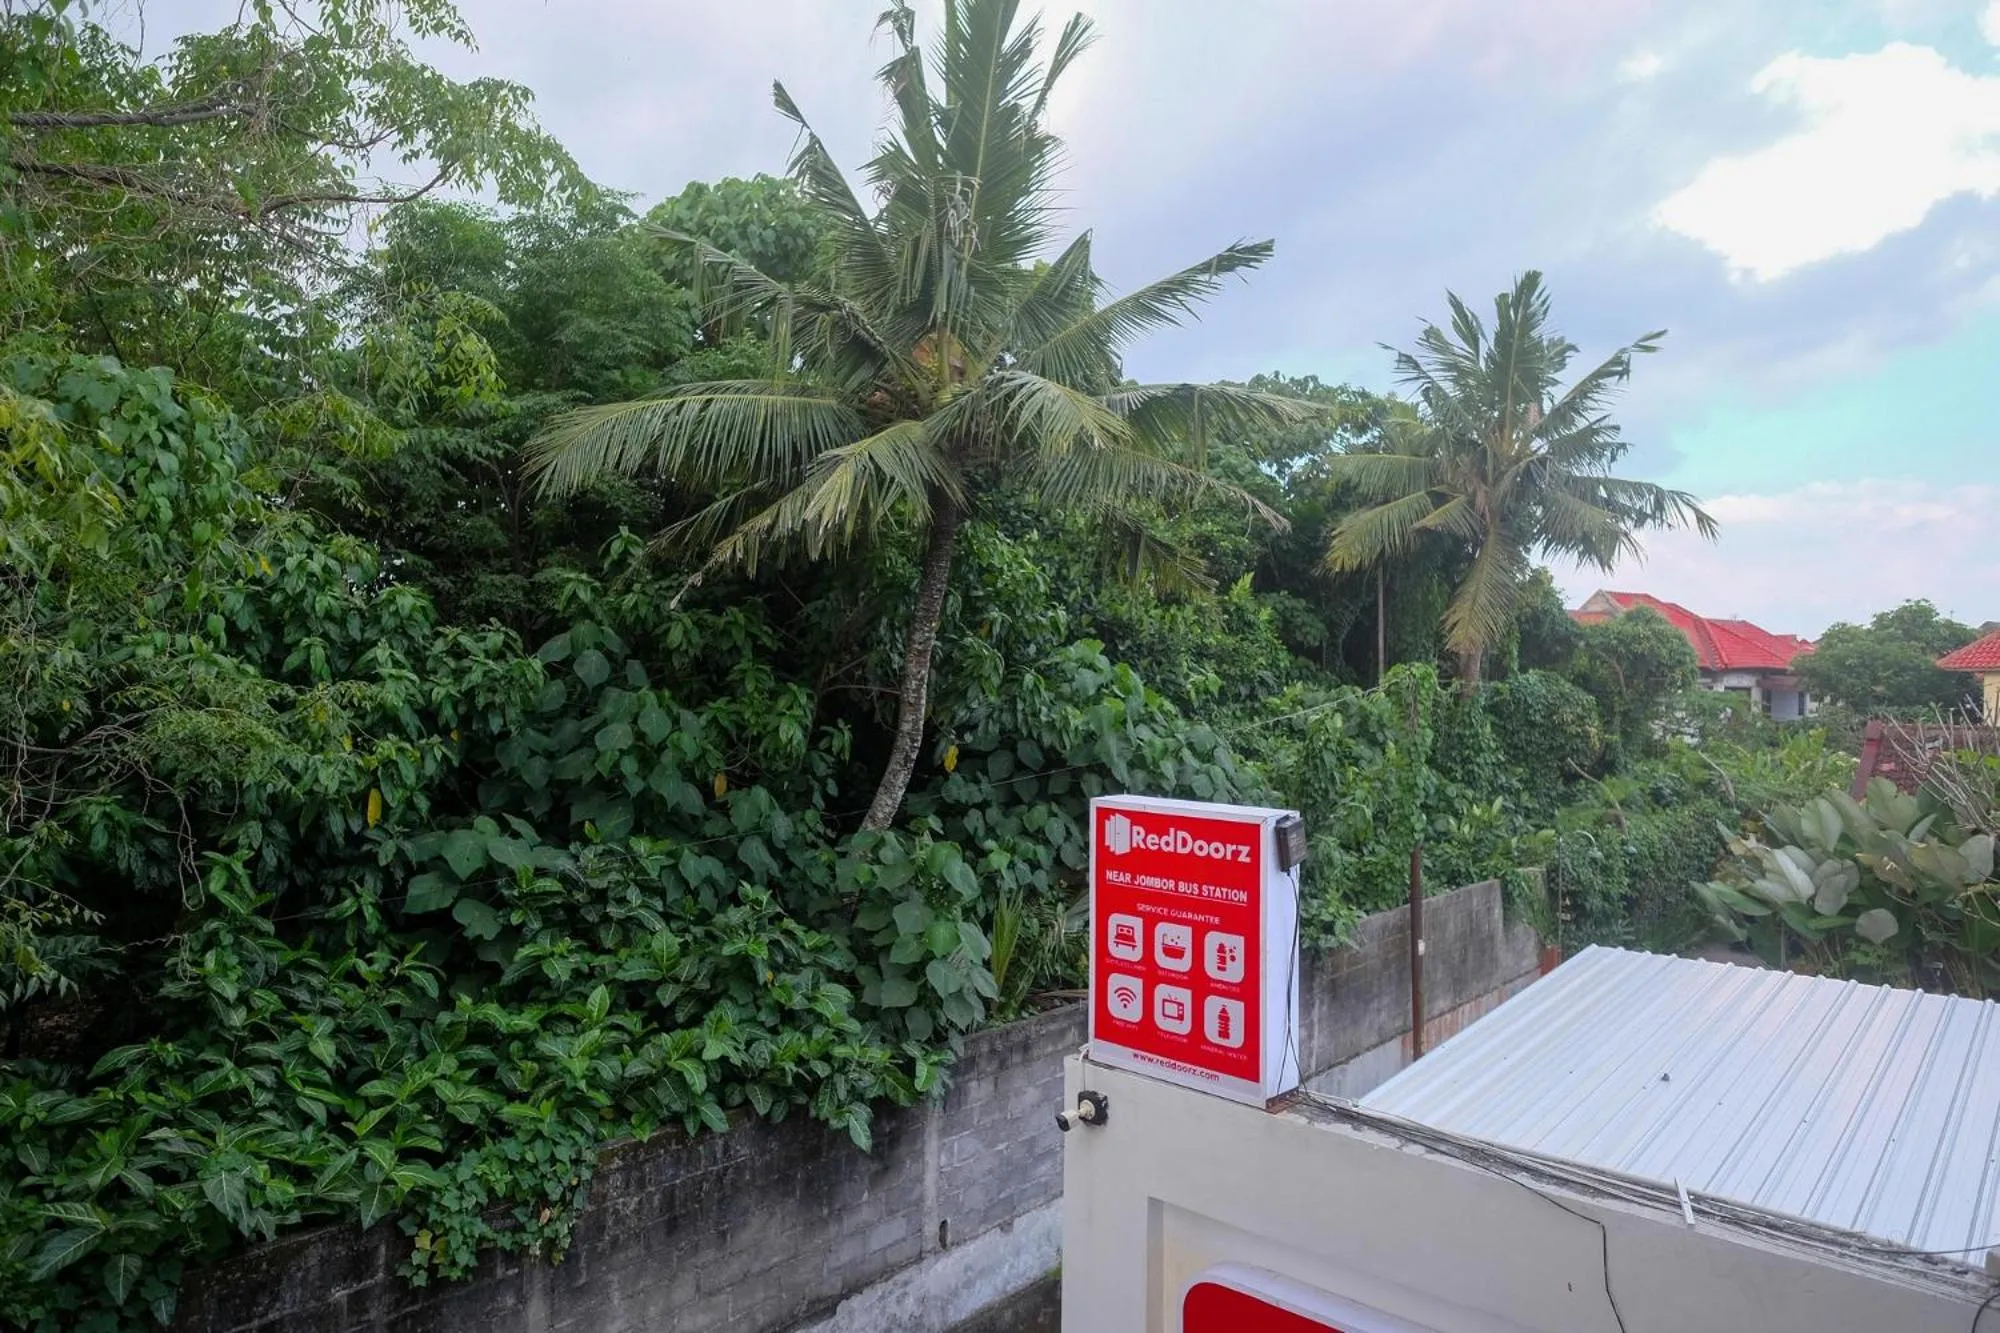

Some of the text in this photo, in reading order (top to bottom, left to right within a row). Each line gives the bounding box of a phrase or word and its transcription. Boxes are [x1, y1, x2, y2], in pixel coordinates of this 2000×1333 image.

[1131, 825, 1251, 863] RedDoorz
[1106, 869, 1248, 902] NEAR JOMBOR BUS STATION
[1136, 903, 1220, 925] SERVICE GUARANTEE
[1132, 1052, 1220, 1081] www.reddoorz.com
